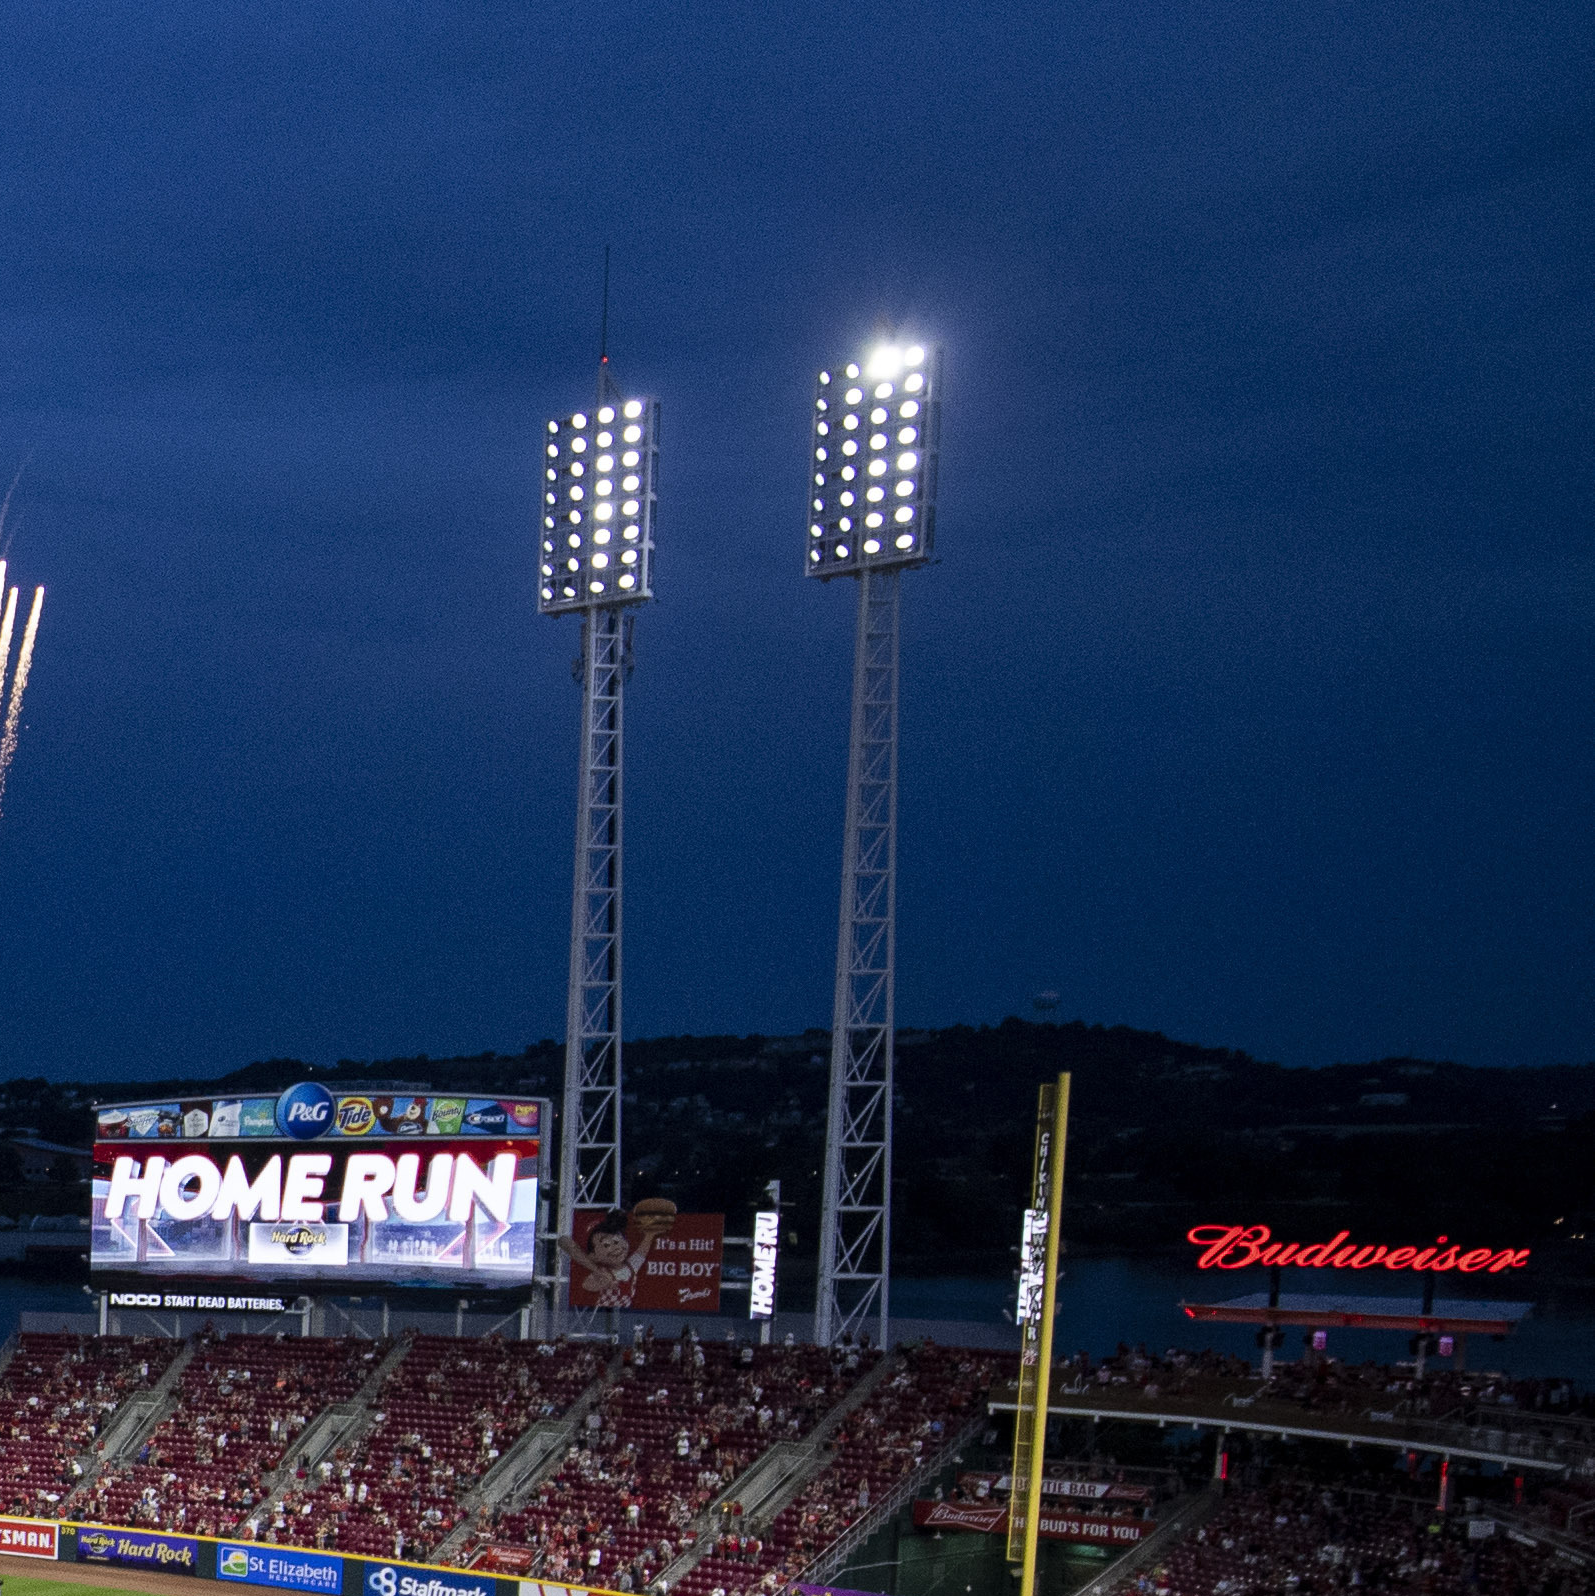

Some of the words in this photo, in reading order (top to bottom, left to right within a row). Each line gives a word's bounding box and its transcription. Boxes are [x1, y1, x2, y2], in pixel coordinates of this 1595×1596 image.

[287, 1101, 330, 1122] P&G
[338, 1104, 373, 1126] Tide
[431, 1107, 462, 1121] Bounty
[105, 1153, 332, 1221] HOME
[339, 1153, 517, 1222] RUN
[270, 1230, 298, 1244] Hard
[298, 1231, 327, 1247] Rock
[655, 1238, 677, 1251] It's
[677, 1241, 687, 1251] a
[689, 1238, 715, 1251] Hit!
[1187, 1224, 1531, 1273] Budweiser
[646, 1261, 676, 1277] BIG
[678, 1261, 717, 1278] BOY
[110, 1292, 161, 1307] NOCO
[163, 1294, 197, 1309] START
[198, 1295, 226, 1309] DEAD
[1069, 1483, 1097, 1497] BAR
[934, 1509, 996, 1524] Budweiser
[60, 1526, 76, 1537] 370
[1039, 1520, 1080, 1535] BUD'S
[1081, 1522, 1109, 1537] FOR
[117, 1538, 154, 1560] Hard
[155, 1542, 193, 1566] Rock
[249, 1555, 267, 1573] St.
[268, 1558, 338, 1582] Elizabeth
[268, 1573, 338, 1590] HEALTHCARE
